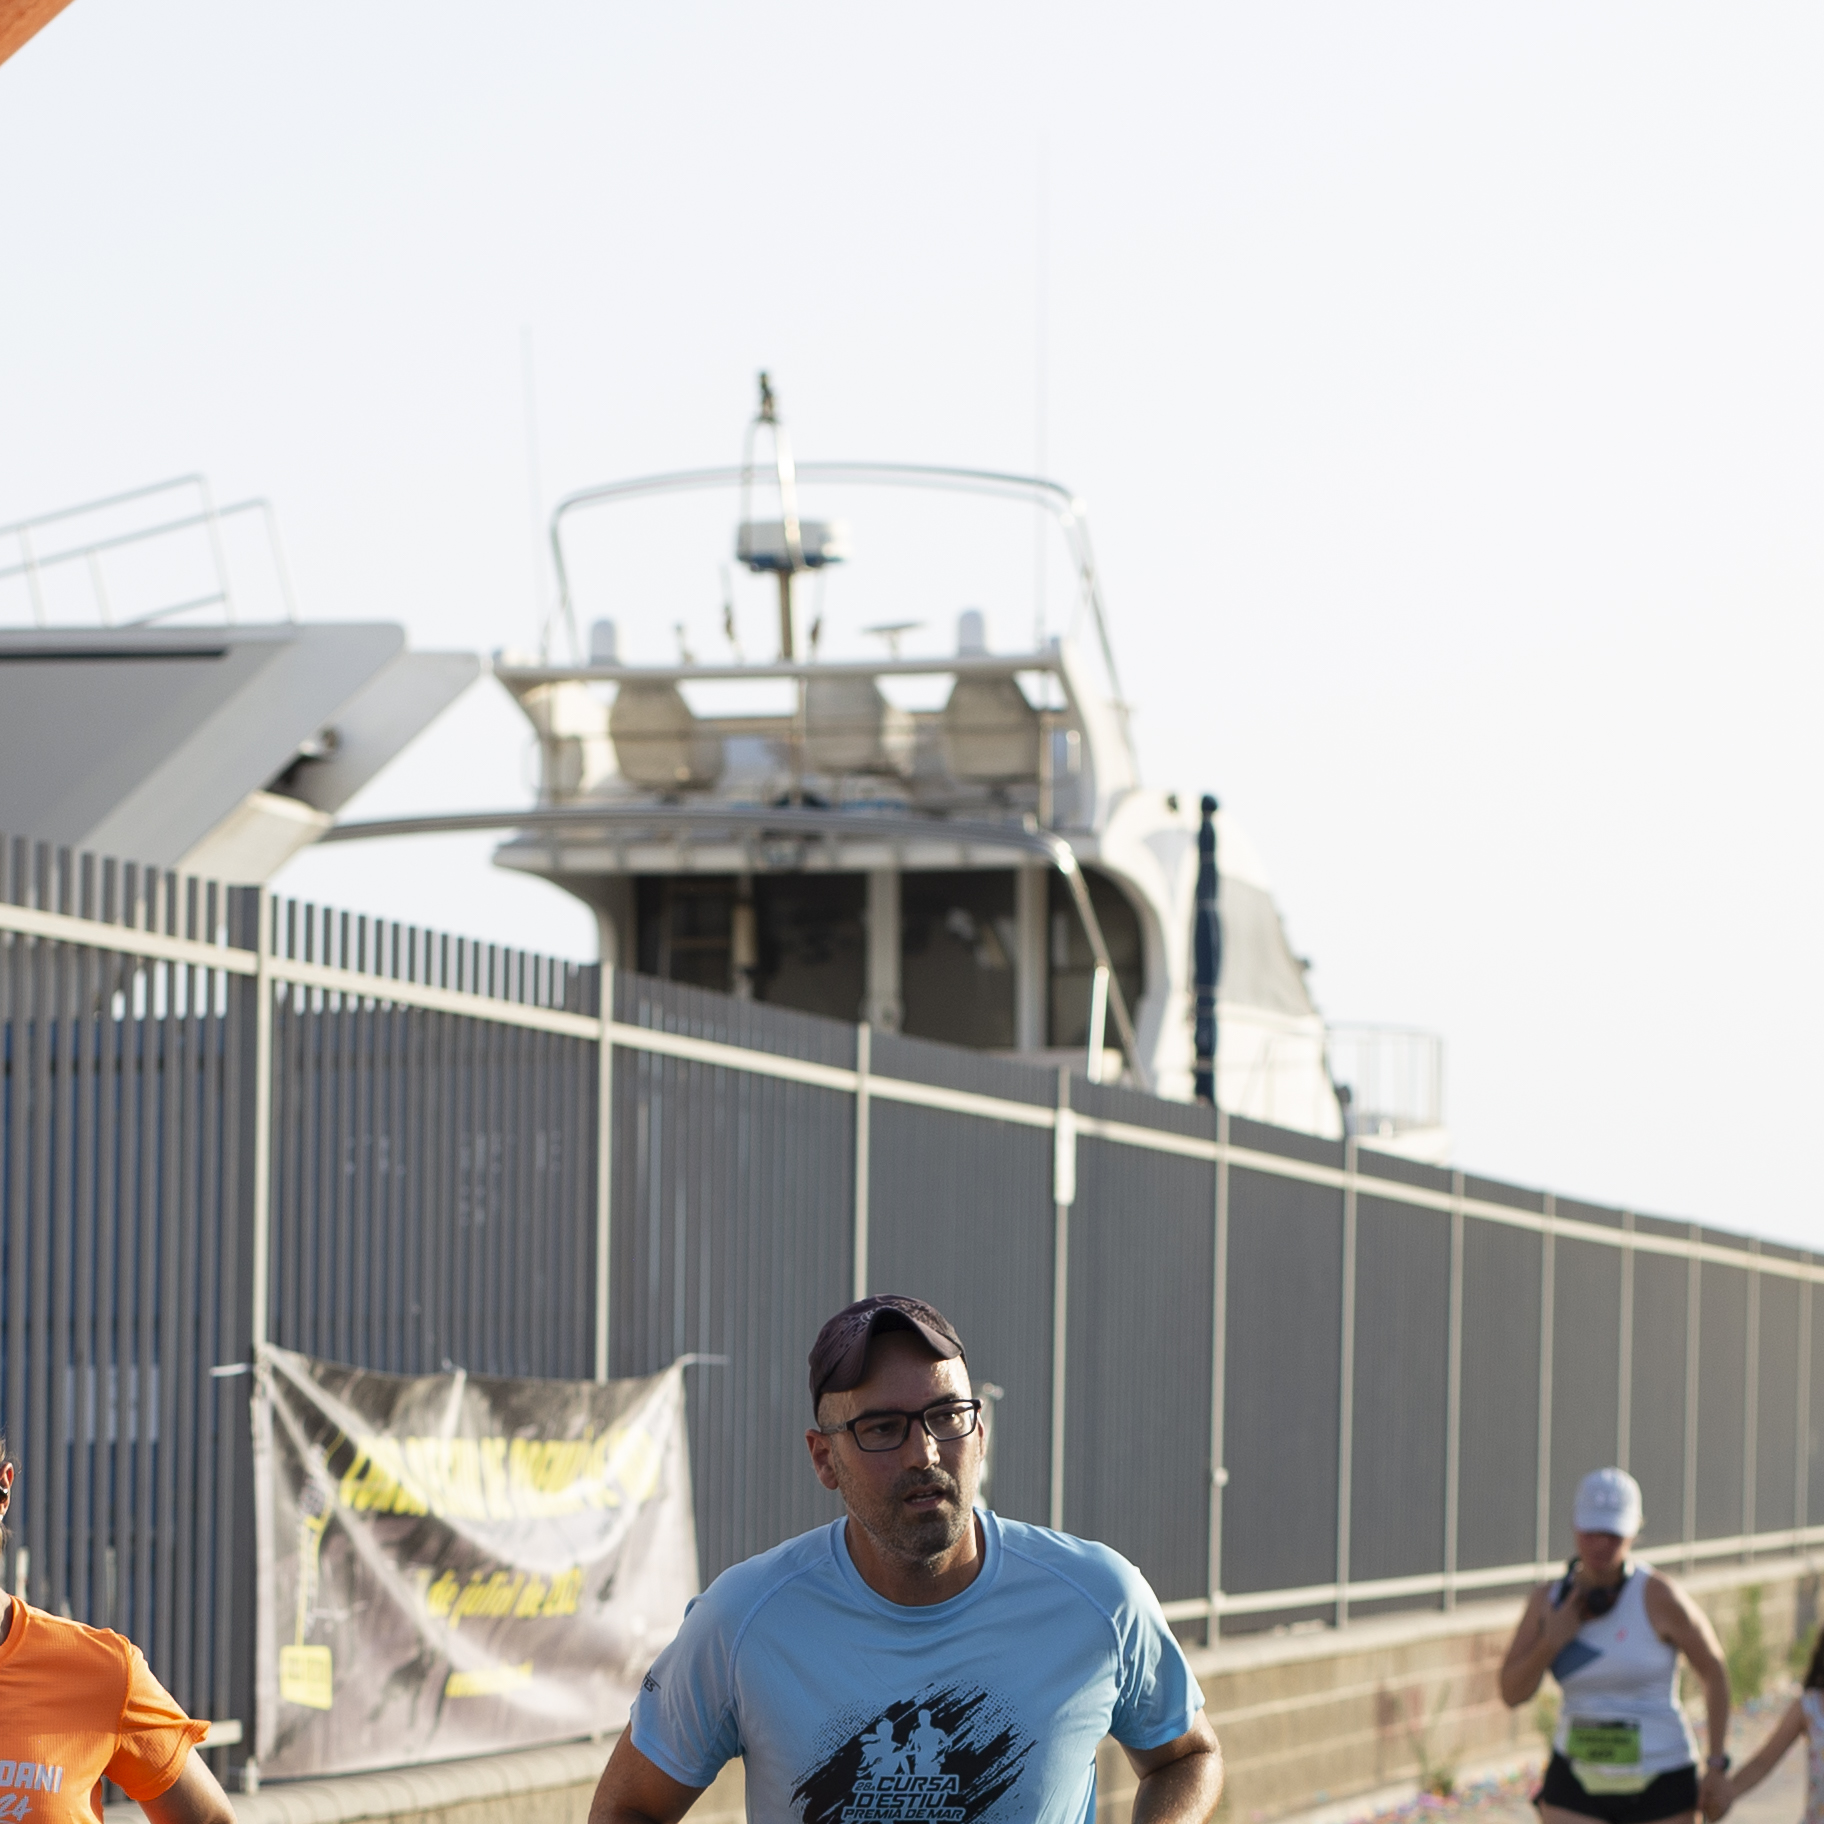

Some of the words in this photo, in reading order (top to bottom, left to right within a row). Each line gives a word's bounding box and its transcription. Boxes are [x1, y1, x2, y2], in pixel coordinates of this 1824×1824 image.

[877, 1776, 958, 1792] CURSA
[856, 1793, 946, 1808] D'ESTIU
[904, 1809, 927, 1819] DE
[927, 1809, 964, 1819] MAR
